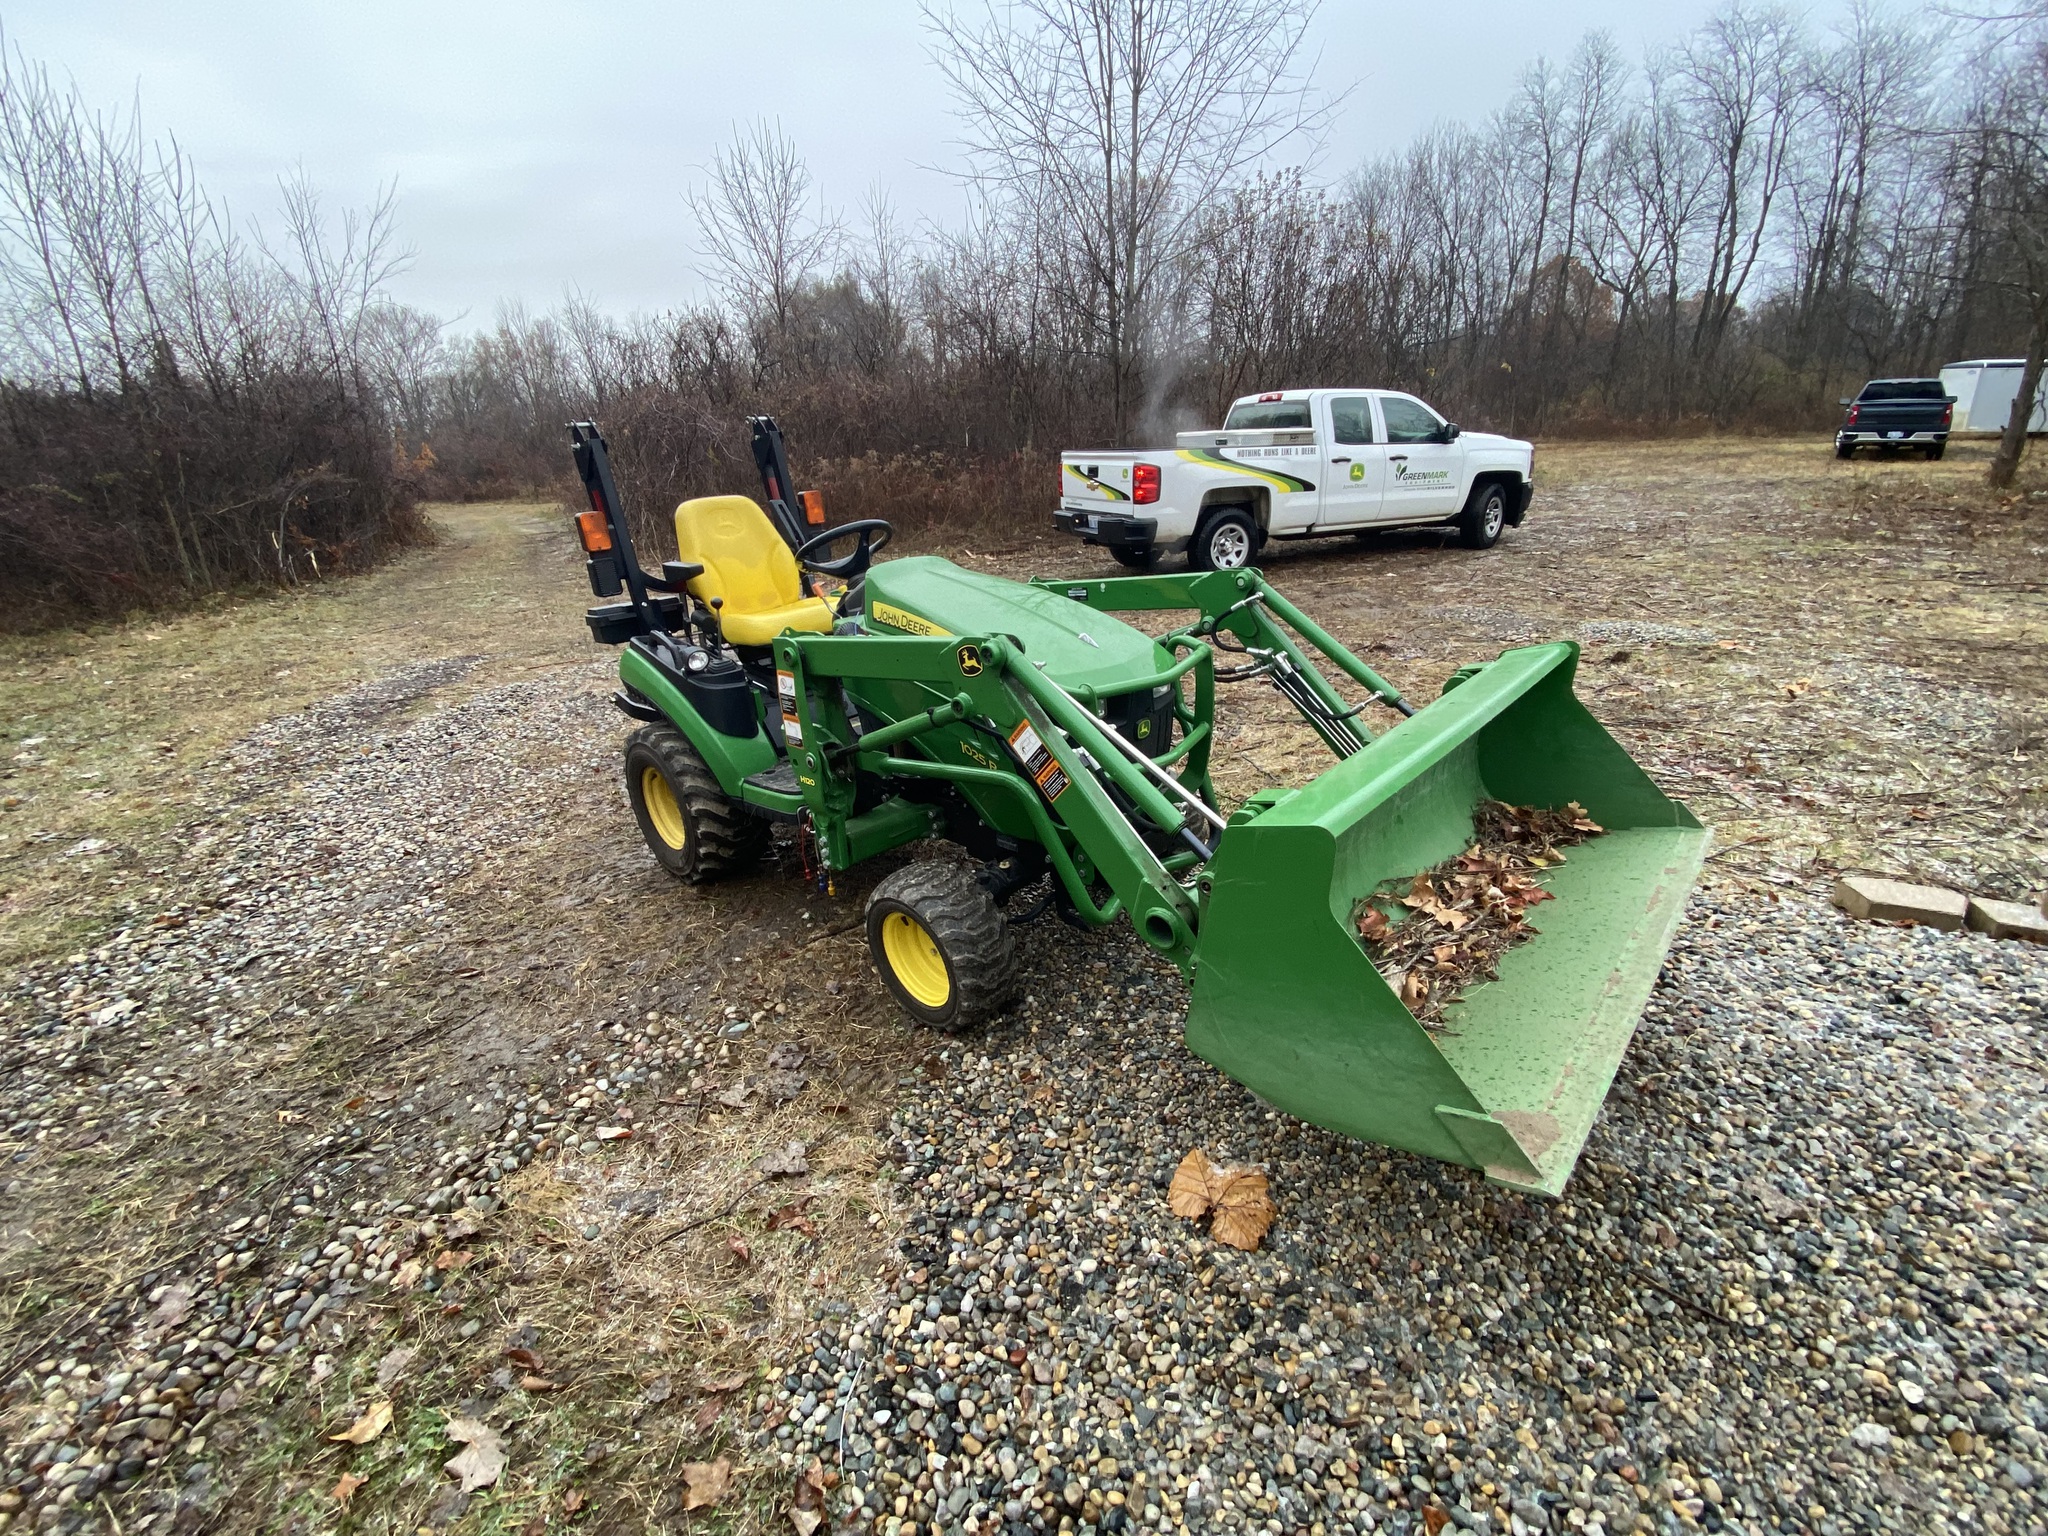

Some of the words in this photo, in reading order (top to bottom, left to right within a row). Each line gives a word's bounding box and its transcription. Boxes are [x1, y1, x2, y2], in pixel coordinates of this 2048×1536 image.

[1236, 449, 1261, 458] NOTHING
[1263, 448, 1279, 457] RUNS
[1281, 447, 1292, 456] LIKE
[1295, 447, 1299, 456] A
[1301, 446, 1317, 455] DEERE
[1402, 470, 1450, 481] GREENMARK
[877, 607, 900, 626] JOHN
[900, 614, 932, 636] DEERE
[959, 740, 987, 766] 1025
